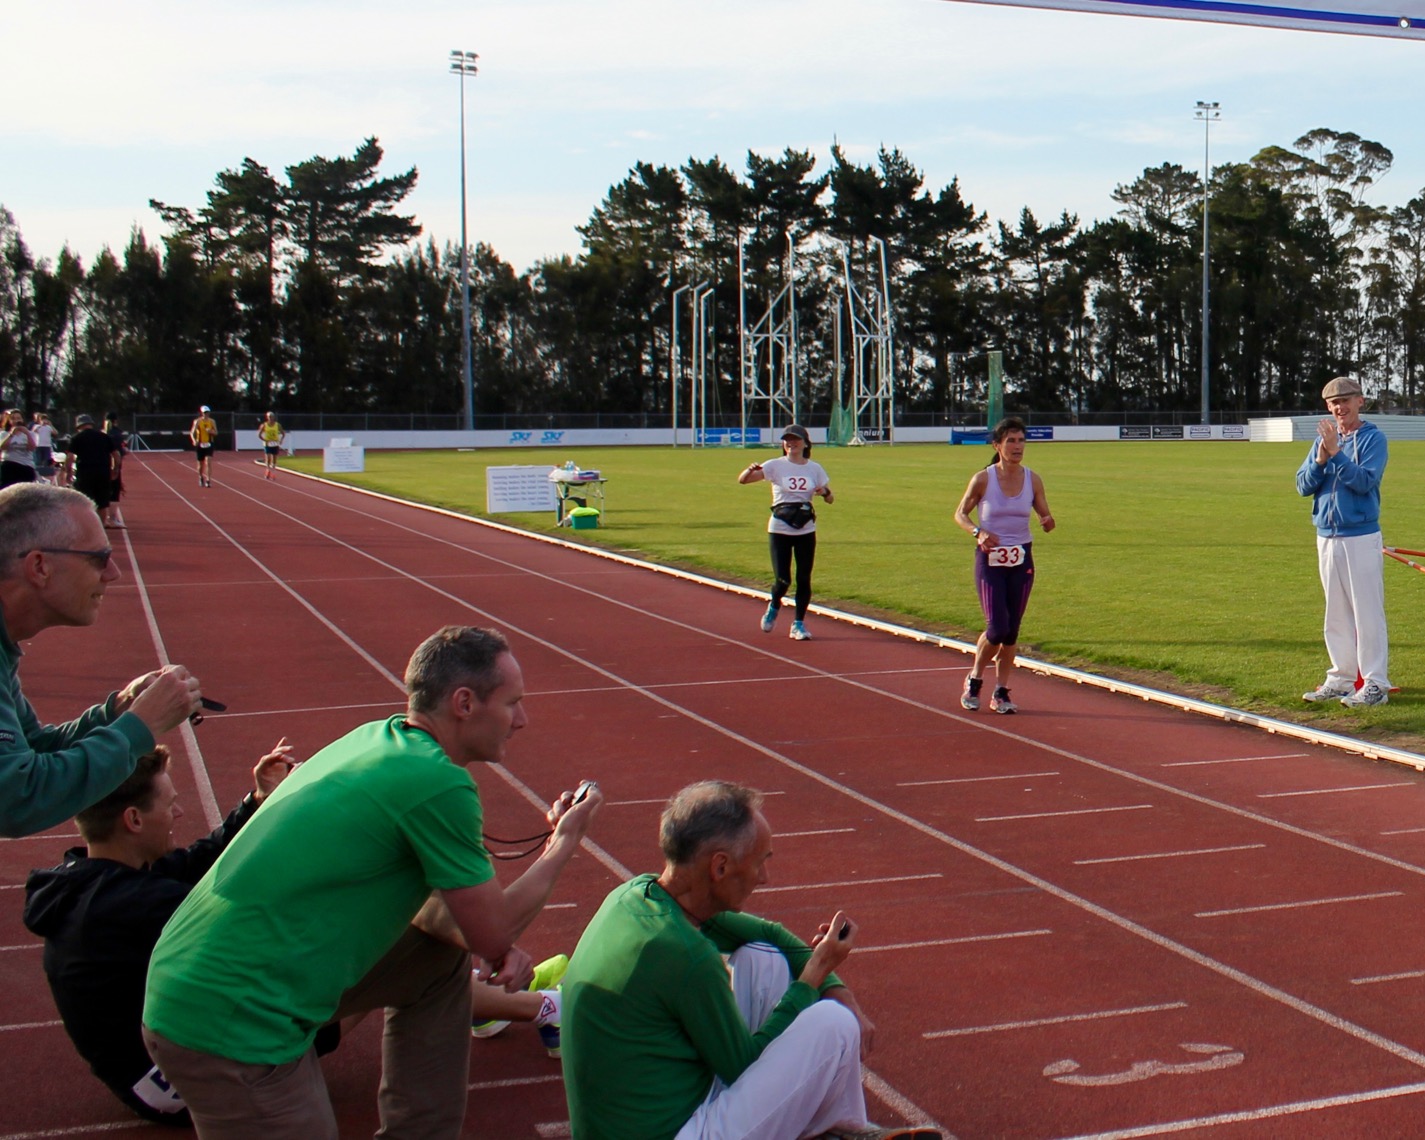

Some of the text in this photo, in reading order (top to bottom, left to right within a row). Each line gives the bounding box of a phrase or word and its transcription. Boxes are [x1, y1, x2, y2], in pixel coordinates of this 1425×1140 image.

[789, 478, 807, 491] 32
[997, 547, 1020, 564] 33
[1042, 1043, 1245, 1087] 3
